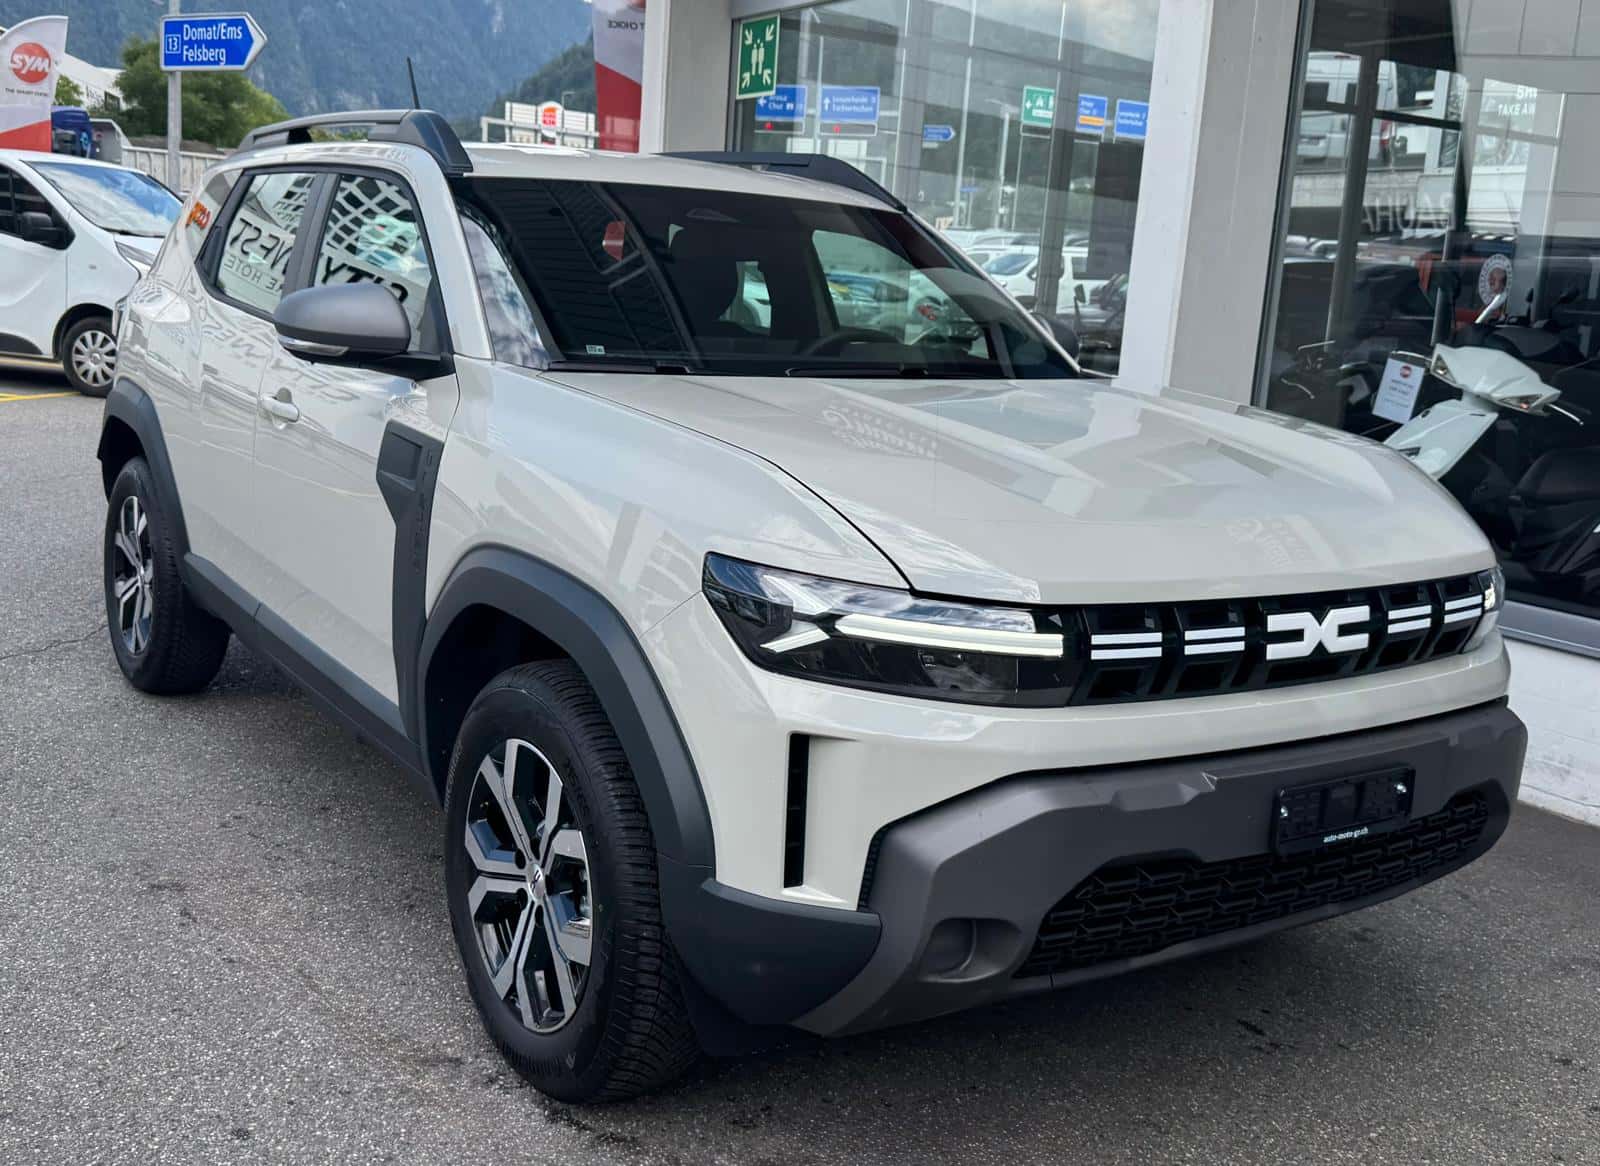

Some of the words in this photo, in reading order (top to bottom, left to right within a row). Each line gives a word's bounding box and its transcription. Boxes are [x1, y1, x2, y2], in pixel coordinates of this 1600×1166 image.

[183, 23, 243, 41] Domat/Ems
[168, 37, 178, 51] 13
[10, 53, 51, 75] SYM
[183, 44, 226, 65] Felsberg
